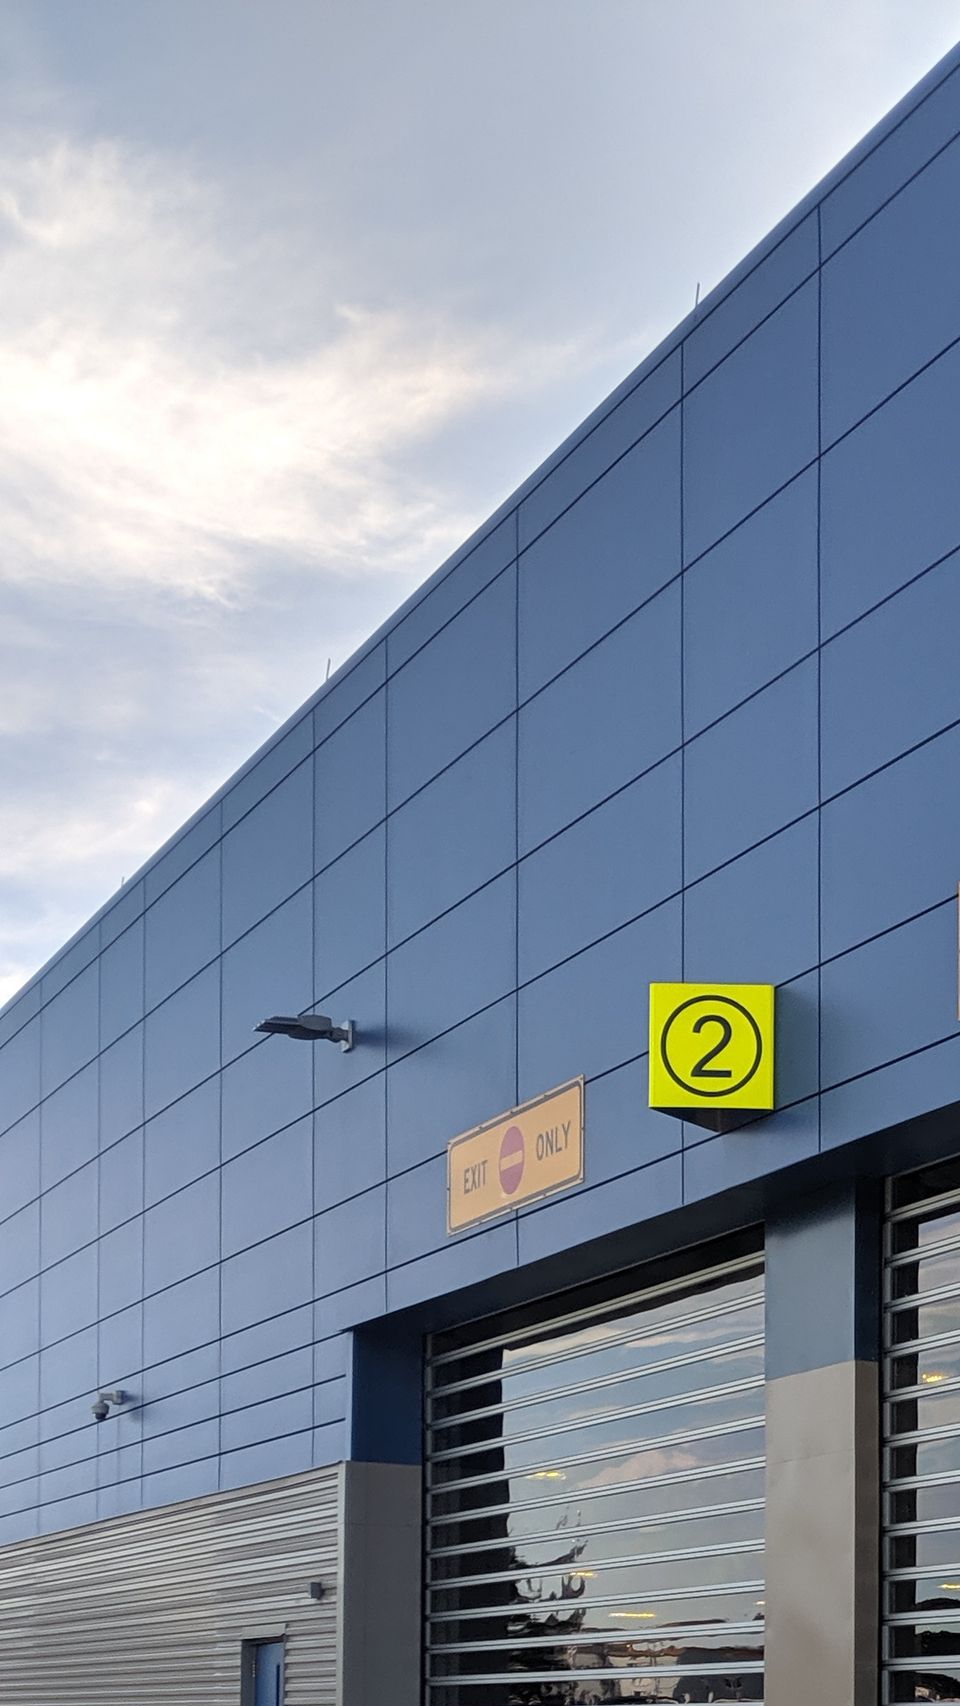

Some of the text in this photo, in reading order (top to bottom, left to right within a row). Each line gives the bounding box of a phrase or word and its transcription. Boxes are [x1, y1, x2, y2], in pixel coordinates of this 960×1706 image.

[690, 1014, 732, 1078] 2
[463, 1120, 571, 1194] EXIT ONLY
